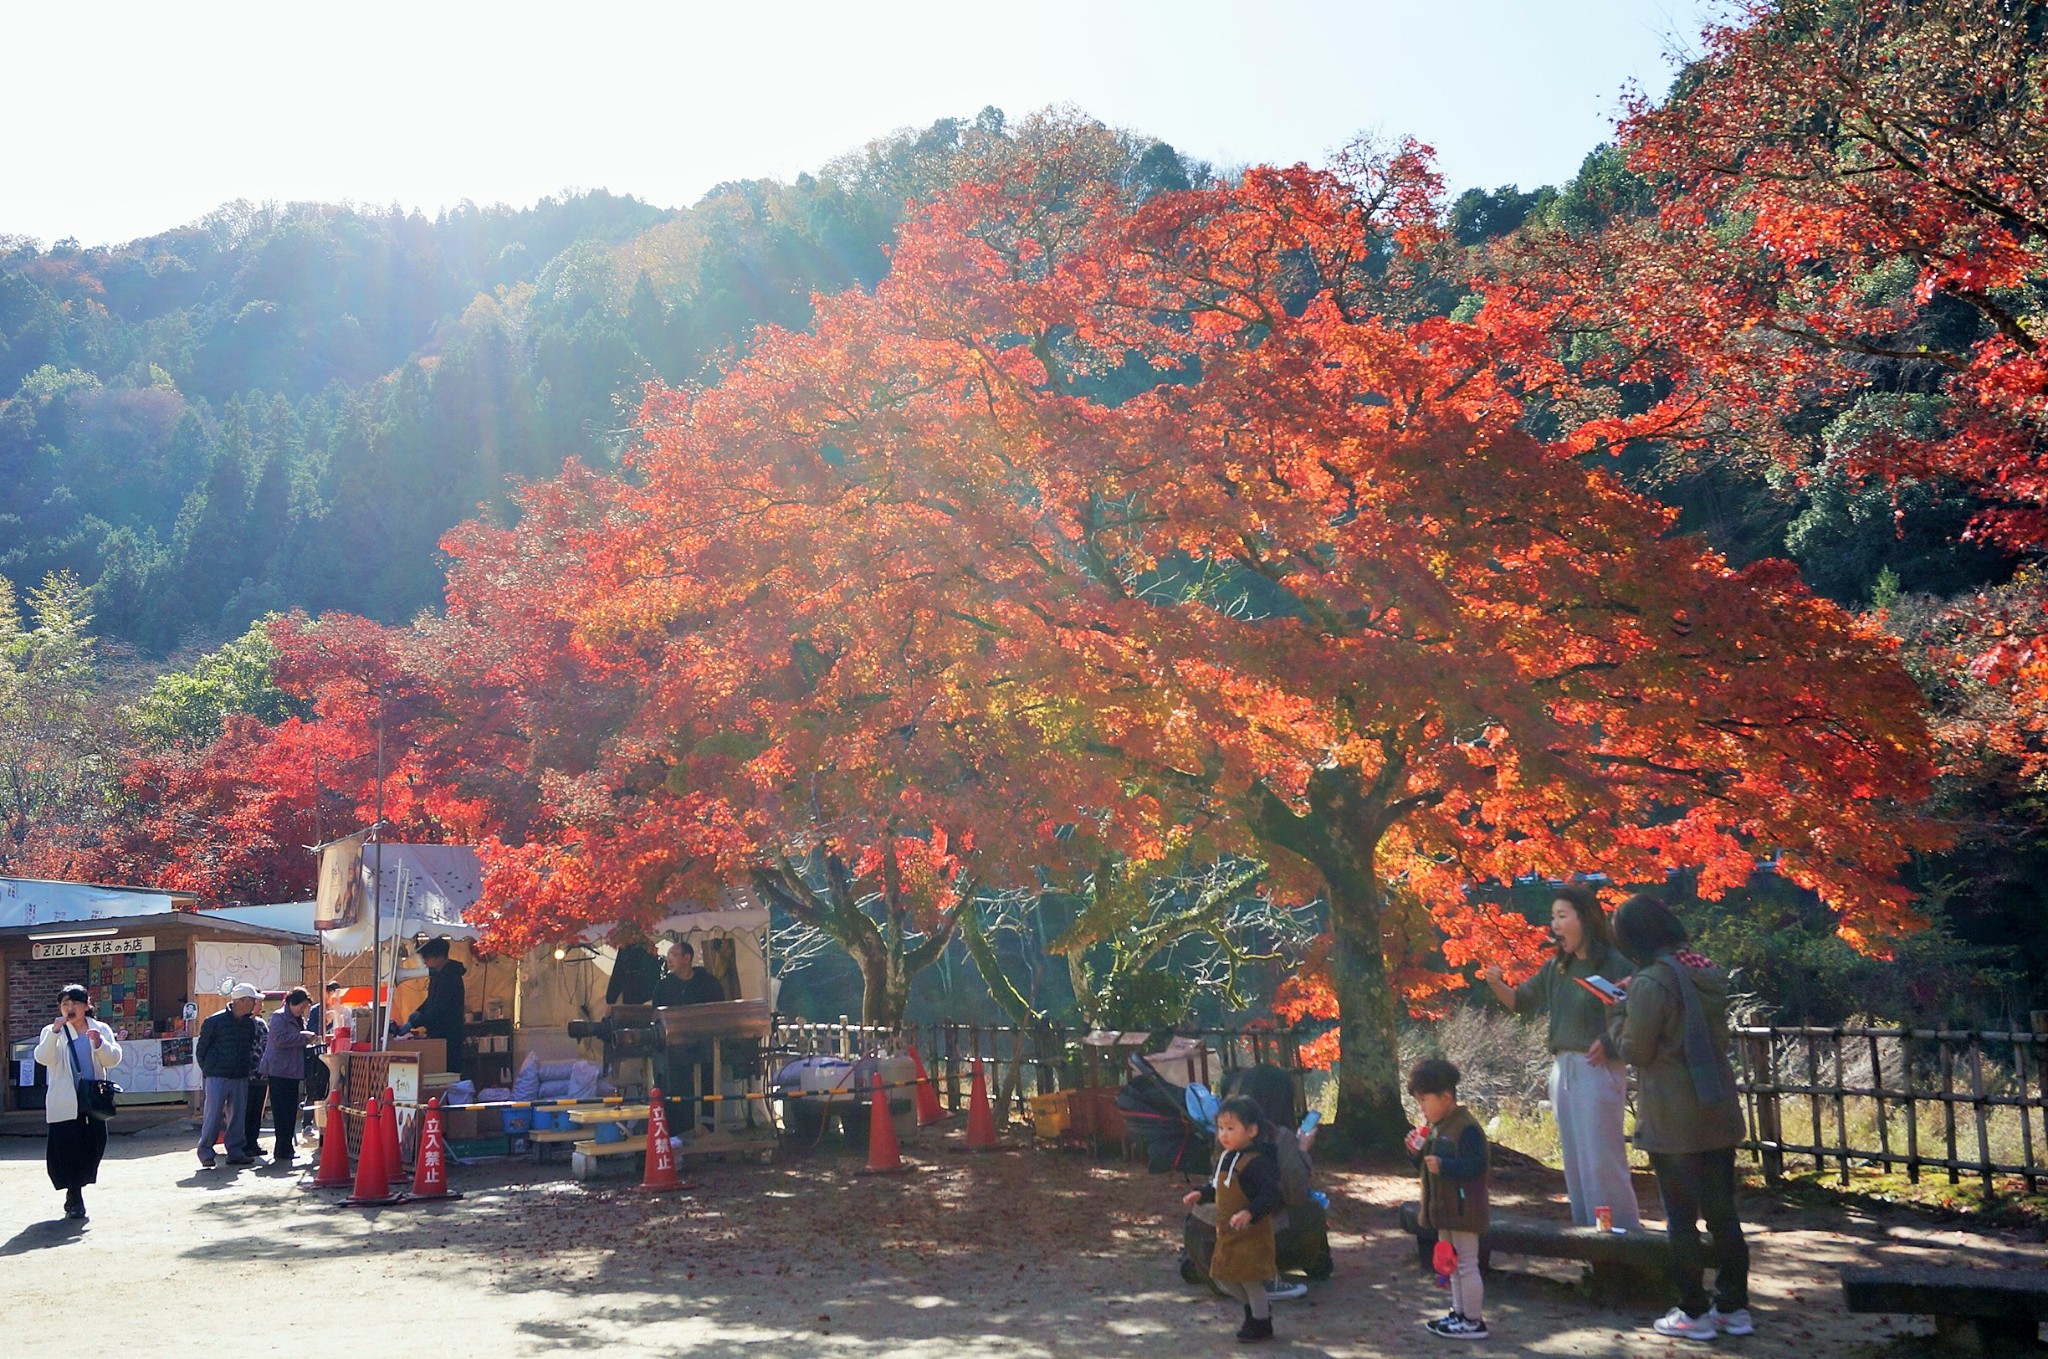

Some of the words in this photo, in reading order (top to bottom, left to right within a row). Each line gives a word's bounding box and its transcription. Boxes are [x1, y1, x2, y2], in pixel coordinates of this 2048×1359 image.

[425, 1118, 440, 1183] 立入禁止
[652, 1105, 671, 1170] 立入禁止
